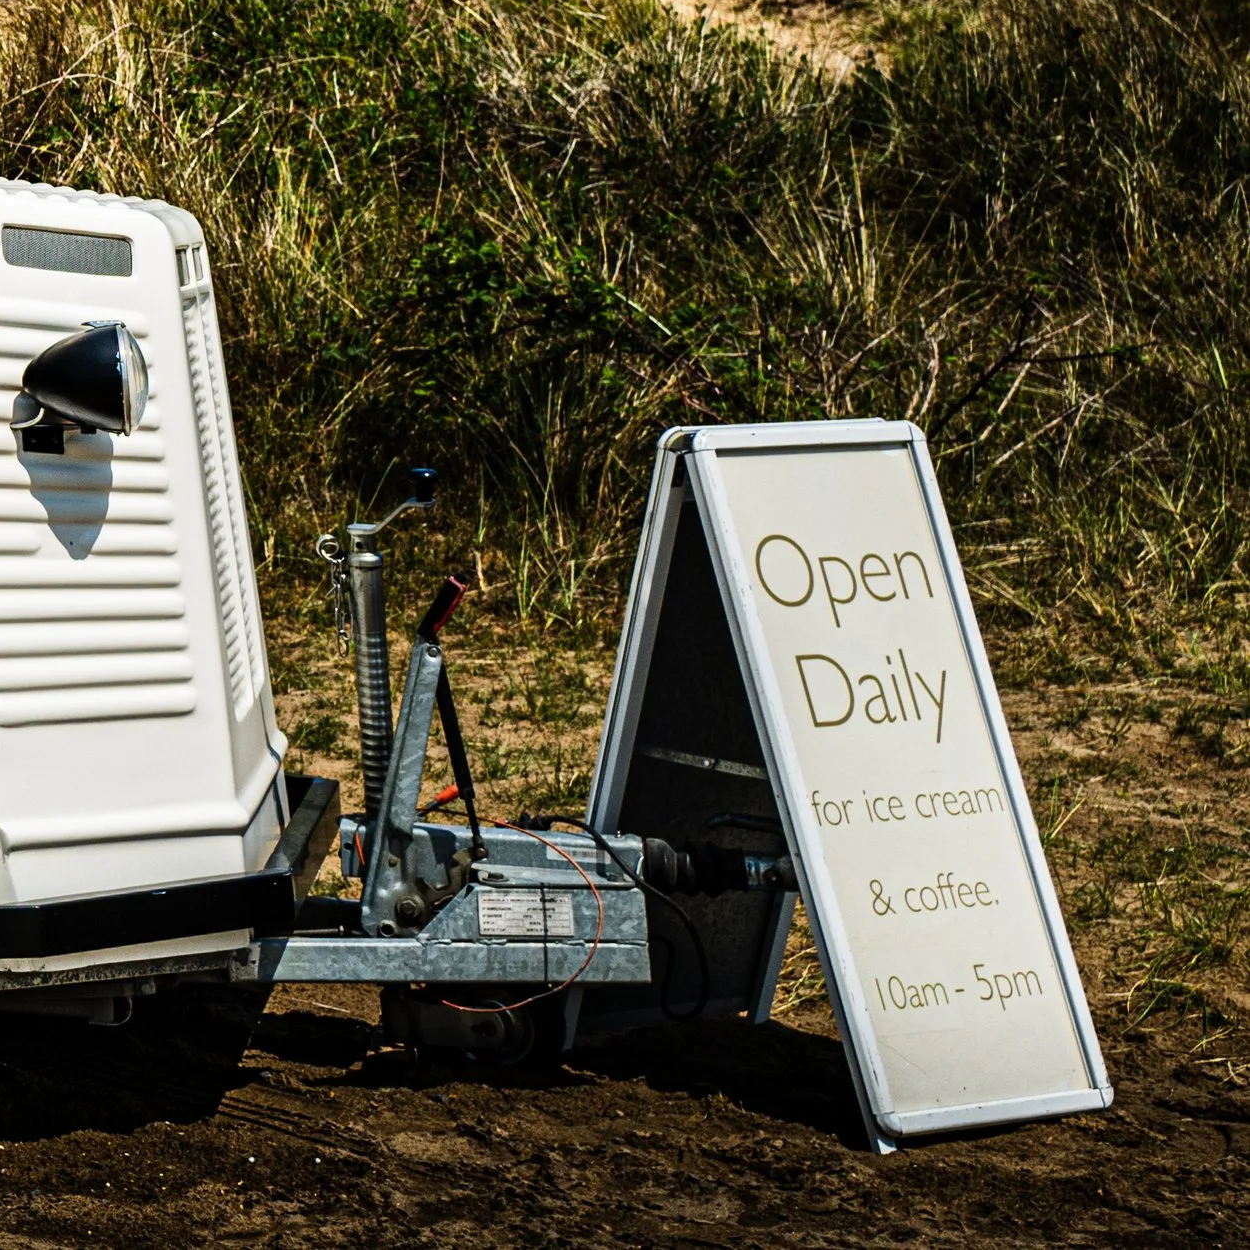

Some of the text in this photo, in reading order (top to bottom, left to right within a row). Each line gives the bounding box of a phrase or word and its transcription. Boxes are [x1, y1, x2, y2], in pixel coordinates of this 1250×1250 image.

[755, 534, 934, 628] Open
[795, 648, 947, 744] Daily
[811, 787, 1004, 827] for ice cream
[869, 872, 999, 916] & coffee.
